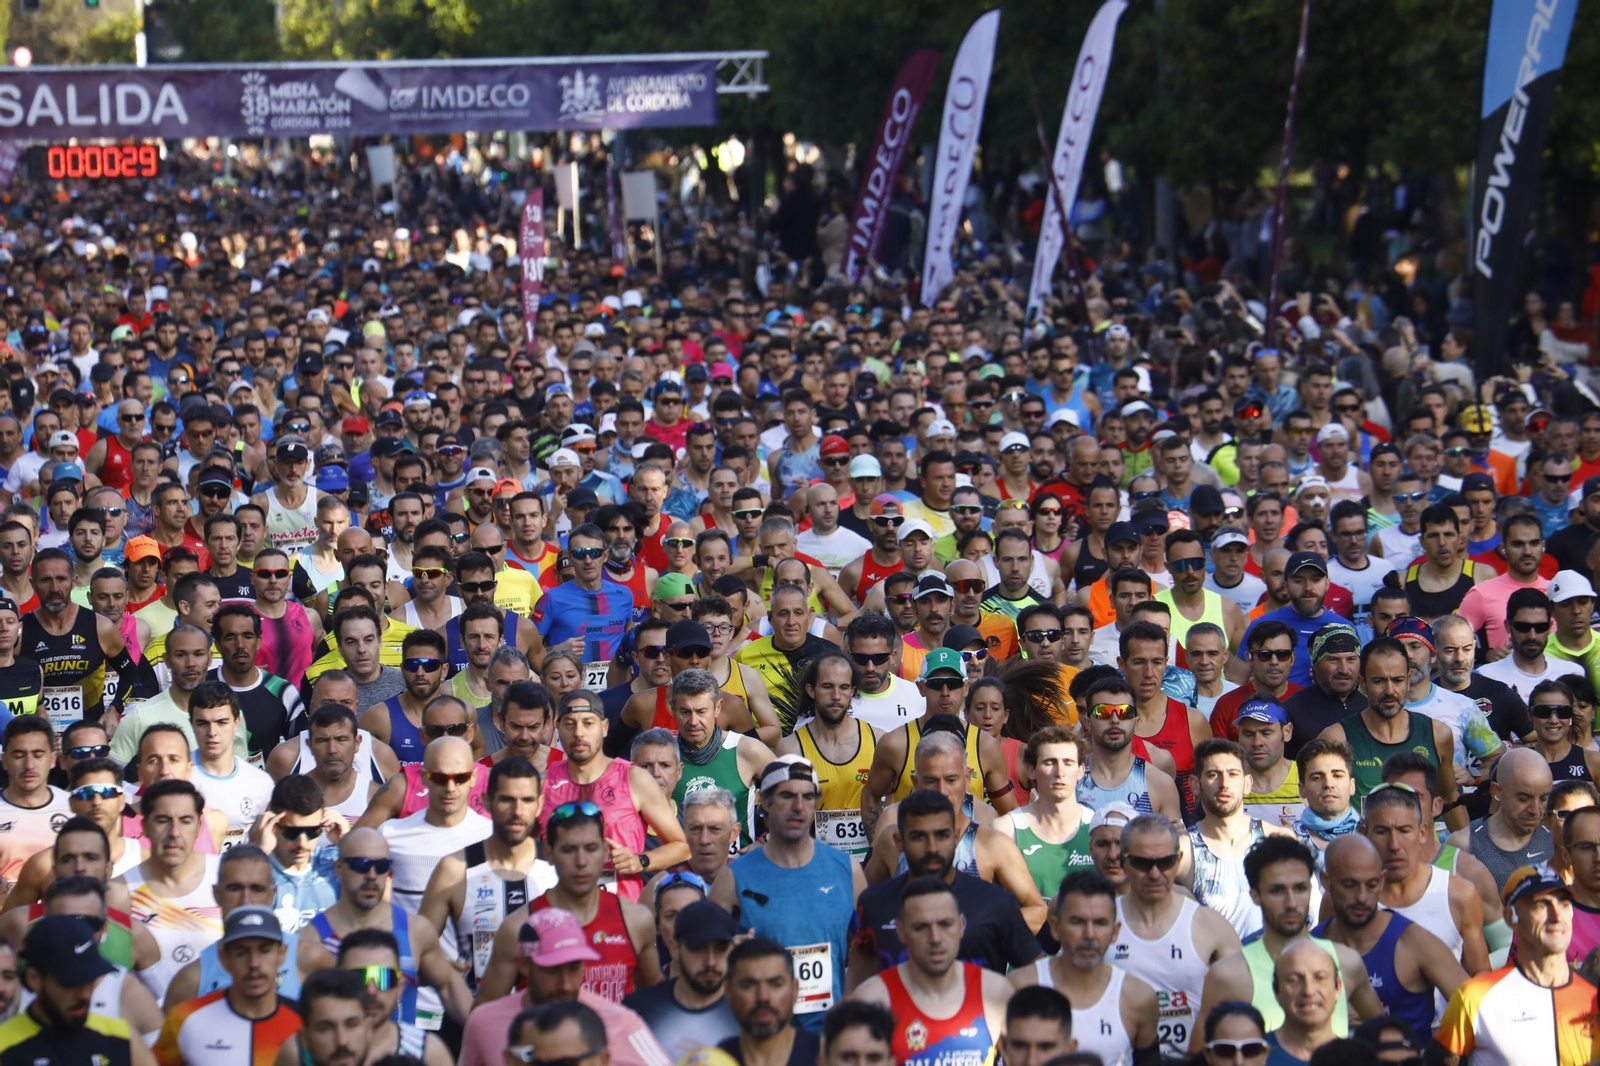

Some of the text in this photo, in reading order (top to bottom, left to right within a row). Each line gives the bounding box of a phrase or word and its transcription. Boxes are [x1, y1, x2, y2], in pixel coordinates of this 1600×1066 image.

[269, 82, 319, 98] MEDIA
[606, 72, 708, 95] AYUNTAMIENTO
[0, 81, 189, 127] SALIDA
[270, 92, 350, 114] MARATÓN
[422, 84, 529, 109] IMDECO
[606, 95, 625, 113] DE
[324, 115, 350, 128] 2024
[852, 87, 912, 249] IMDECO
[44, 660, 90, 674] RUNCI
[588, 672, 605, 686] 27
[44, 696, 81, 711] 2616
[835, 821, 867, 839] 639
[583, 960, 627, 981] UNDACIÓN
[798, 960, 824, 981] 60
[1158, 1023, 1187, 1044] 29
